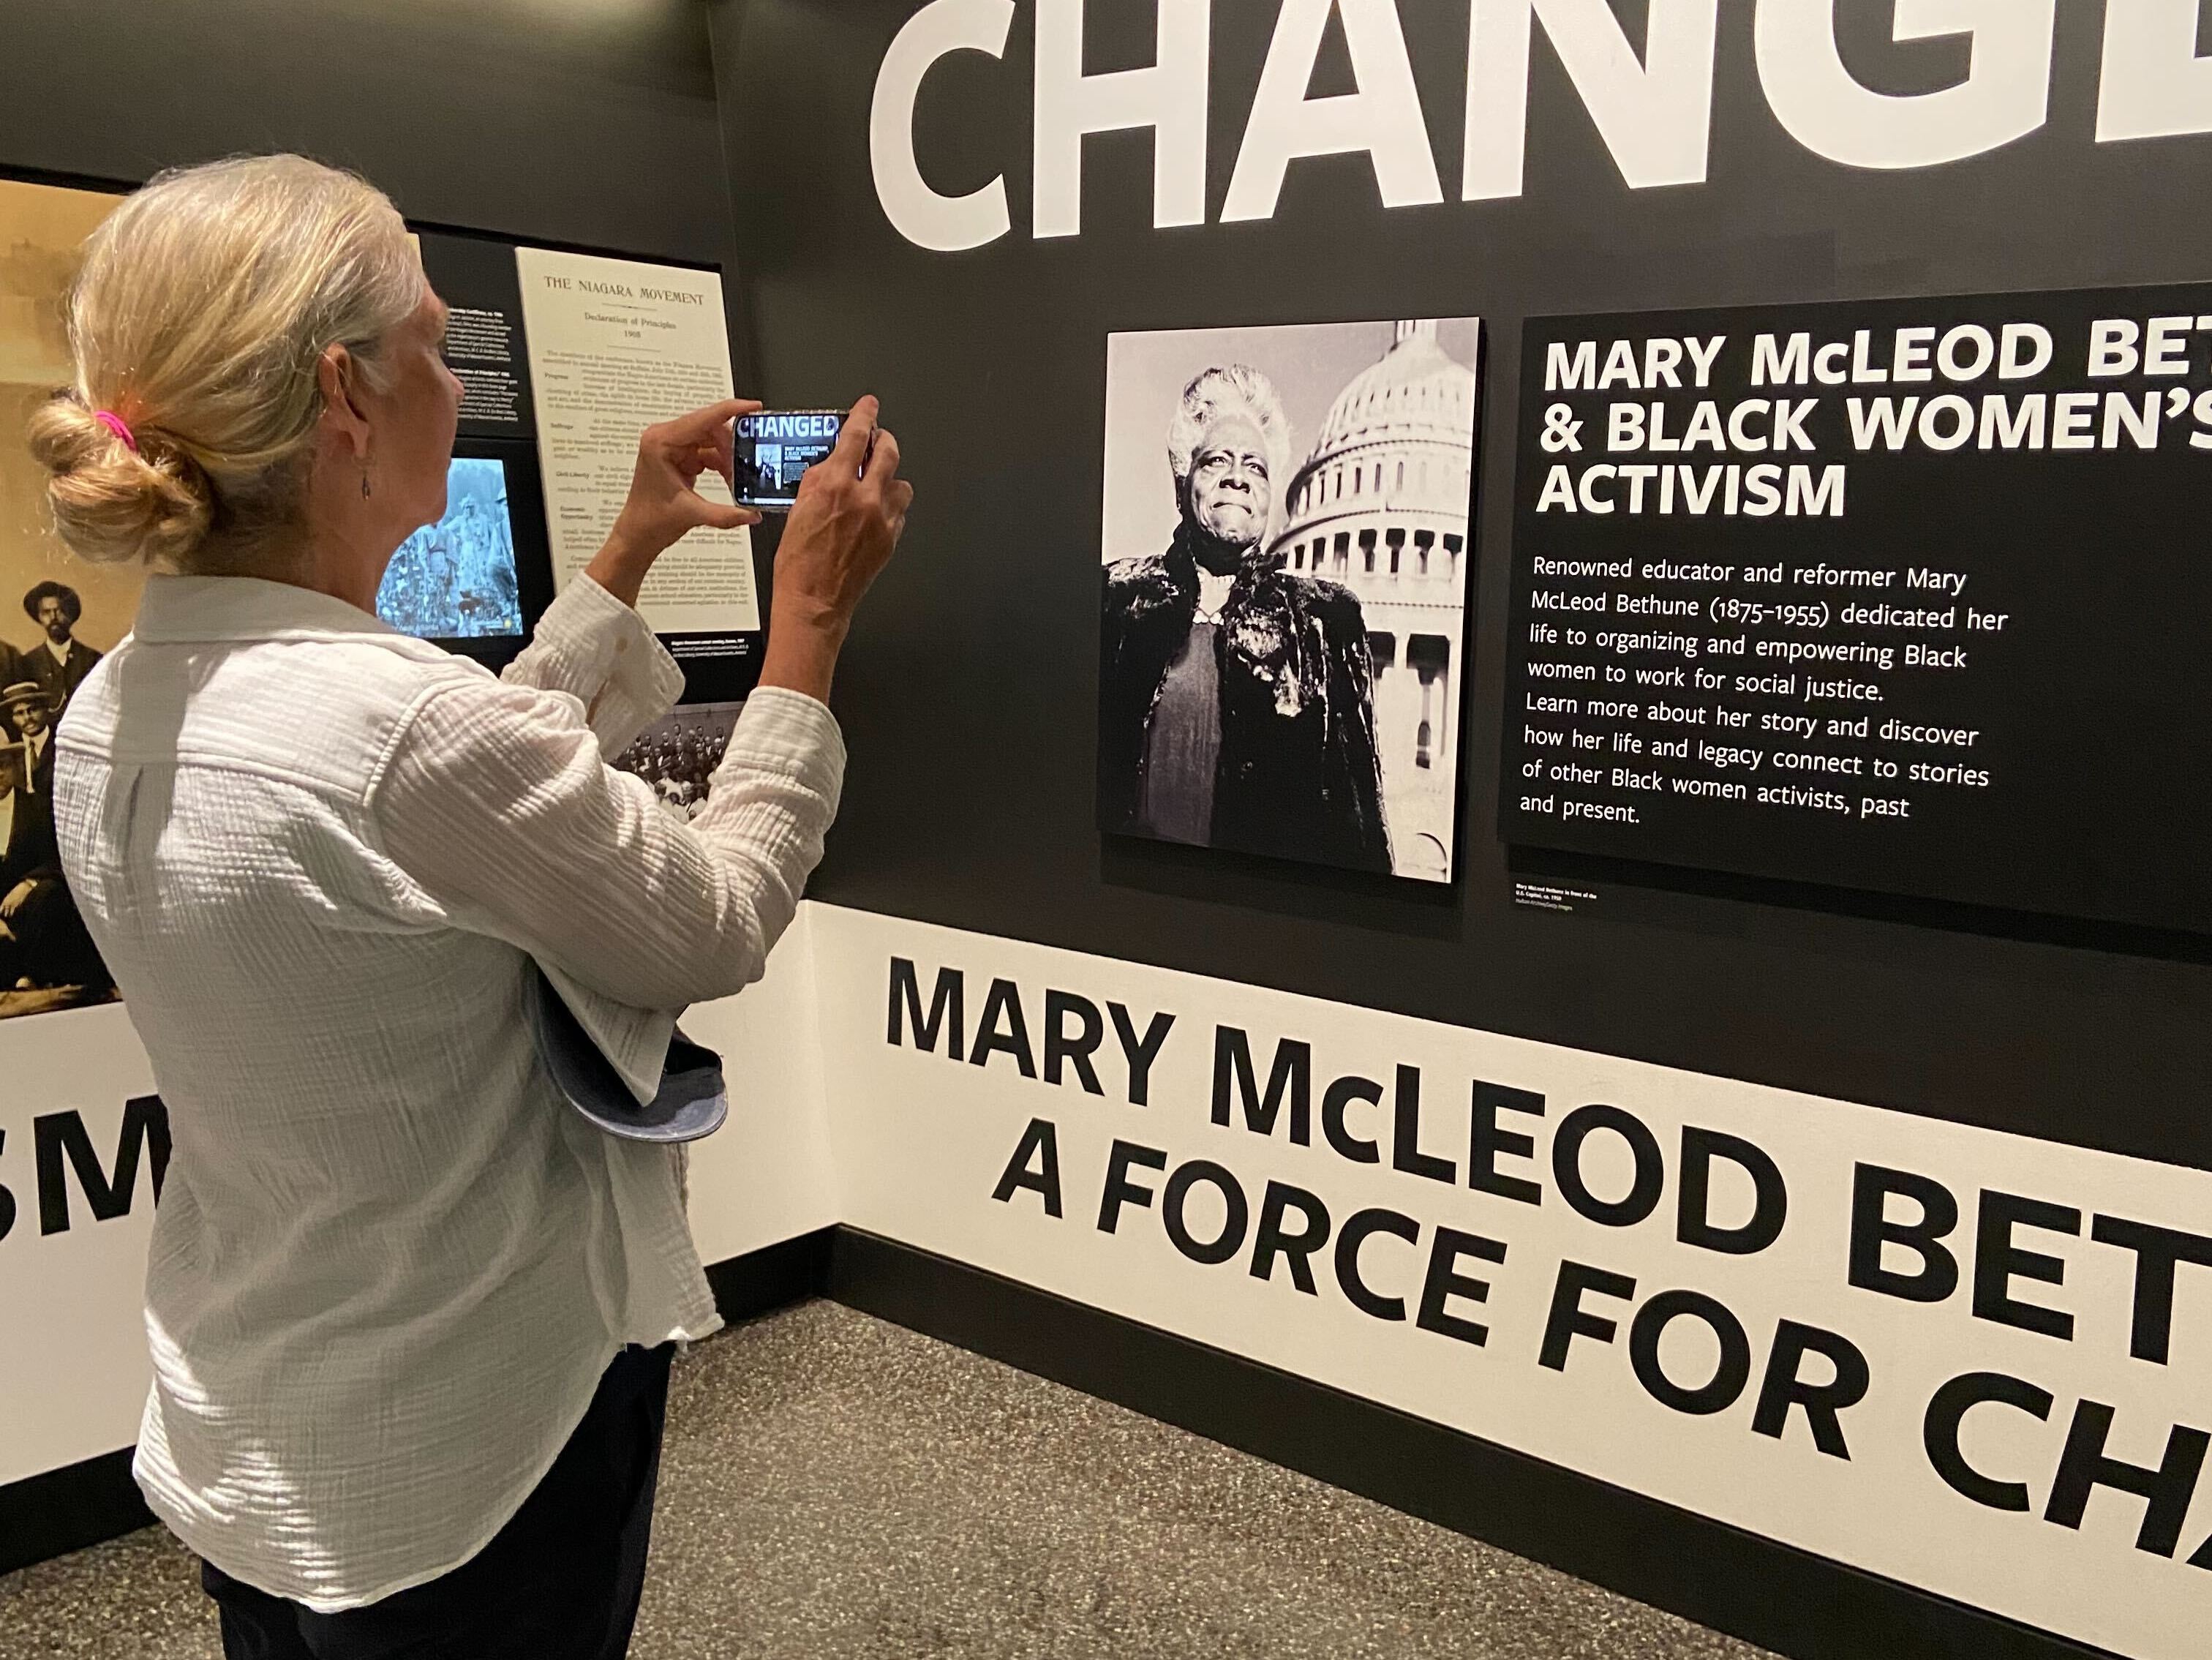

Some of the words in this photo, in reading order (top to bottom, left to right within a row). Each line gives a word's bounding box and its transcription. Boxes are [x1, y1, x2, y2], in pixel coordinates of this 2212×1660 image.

[544, 276, 571, 290] THE
[579, 279, 633, 298] NIAGARA
[640, 288, 704, 305] MOVEMENT
[584, 312, 628, 325] Declaration
[631, 317, 638, 326] of
[641, 318, 677, 330] Principles
[1544, 335, 1727, 391] MARY
[1750, 323, 2053, 386] McLEOD
[737, 416, 840, 438] CHANGED
[1540, 402, 1584, 453] &
[1607, 398, 1819, 452] BLACK
[1535, 463, 1846, 517] ACTIVISM
[1533, 556, 1633, 578] Renowned
[1641, 558, 1735, 582] educator
[1743, 562, 1783, 583] and
[1794, 563, 1897, 587] reformer
[1906, 567, 1967, 596] Mary
[1531, 590, 1606, 612] McLeod
[1616, 593, 1699, 617] Bethune
[1840, 602, 1955, 628] dedicated
[1967, 606, 2009, 631] her
[1530, 623, 1557, 644] life
[1566, 628, 1587, 645] to
[1595, 630, 1698, 658] organizing
[1707, 634, 1745, 655] and
[1755, 641, 1895, 670] empowering
[1905, 643, 1967, 668] Black
[1527, 662, 1596, 680] women
[1606, 664, 1626, 683] to
[1636, 666, 1685, 687] work
[1694, 667, 1726, 689] for
[1734, 673, 1795, 694] social
[1804, 675, 1884, 702] justice.
[1526, 691, 1578, 714] Learn
[1587, 701, 1639, 718] more
[1647, 700, 1707, 724] about
[1716, 705, 1752, 728] her
[1761, 713, 1818, 739] story
[1827, 716, 1868, 737] and
[1879, 718, 1979, 746] discover
[1524, 724, 1564, 746] how
[1572, 728, 1605, 750] her
[1613, 732, 1642, 754] life
[1651, 738, 1688, 758] and
[1698, 739, 1764, 771] legacy
[1772, 752, 1863, 775] connect
[1873, 758, 1897, 778] to
[1908, 762, 1990, 786] stories
[1520, 794, 1554, 813] and
[1562, 801, 1640, 824] present.
[1522, 759, 1543, 778] of
[1550, 762, 1603, 784] other
[1611, 767, 1663, 791] Black
[1671, 778, 1747, 800] women
[1756, 785, 1850, 815] activists,
[1861, 797, 1910, 819] past
[0, 1094, 173, 1243] M
[887, 956, 1176, 1107] MARY
[1211, 1024, 1787, 1255] McLEOD
[1848, 1161, 2212, 1366] BET
[991, 1117, 1063, 1219] A
[1096, 1138, 1508, 1348] FORCE
[1538, 1259, 1870, 1462] FOR
[1923, 1372, 2212, 1571] CH
